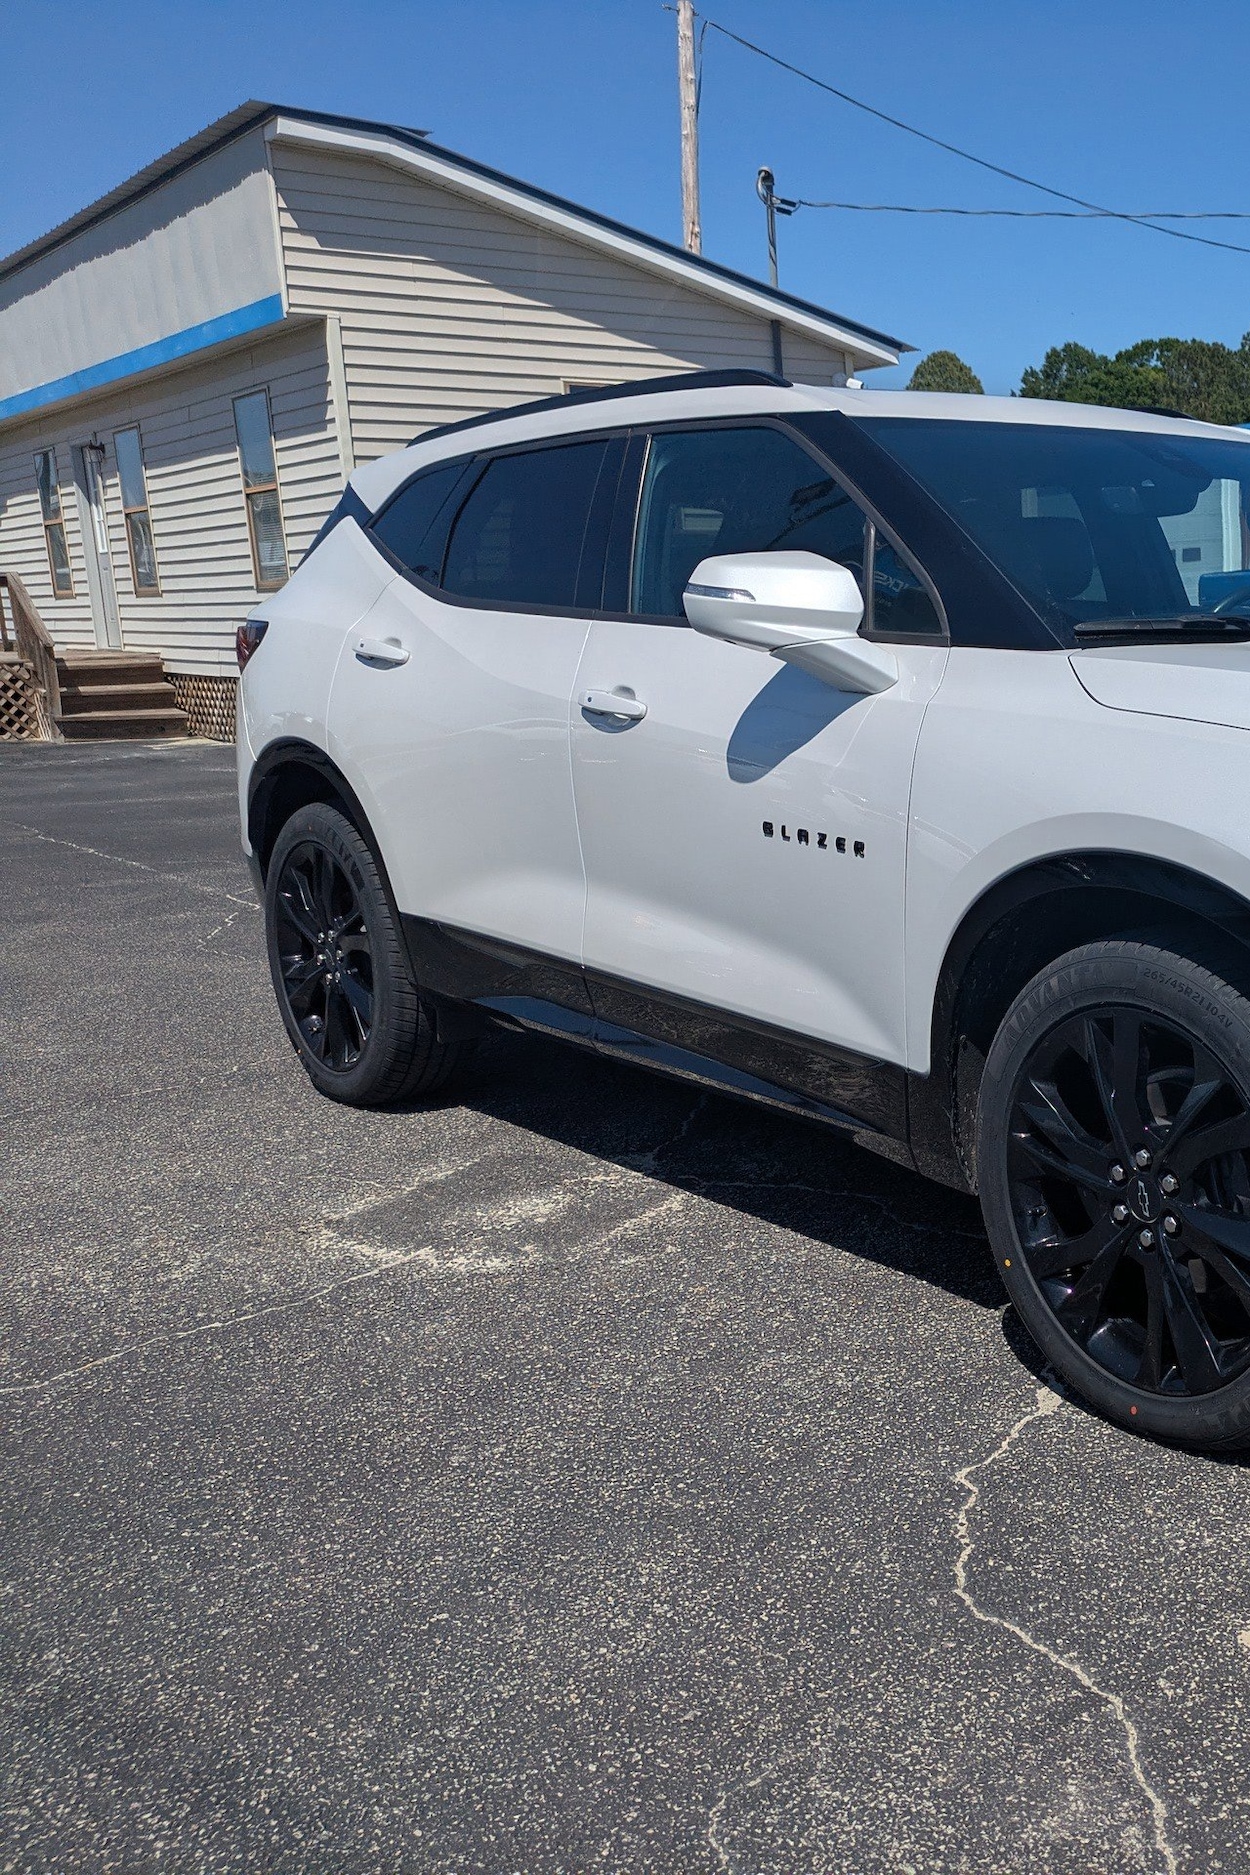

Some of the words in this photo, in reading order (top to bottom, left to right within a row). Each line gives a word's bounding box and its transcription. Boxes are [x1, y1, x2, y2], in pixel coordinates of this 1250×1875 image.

[762, 821, 865, 858] BLAZER
[1143, 968, 1206, 1008] 265/45R21
[1205, 1002, 1233, 1029] 104V
